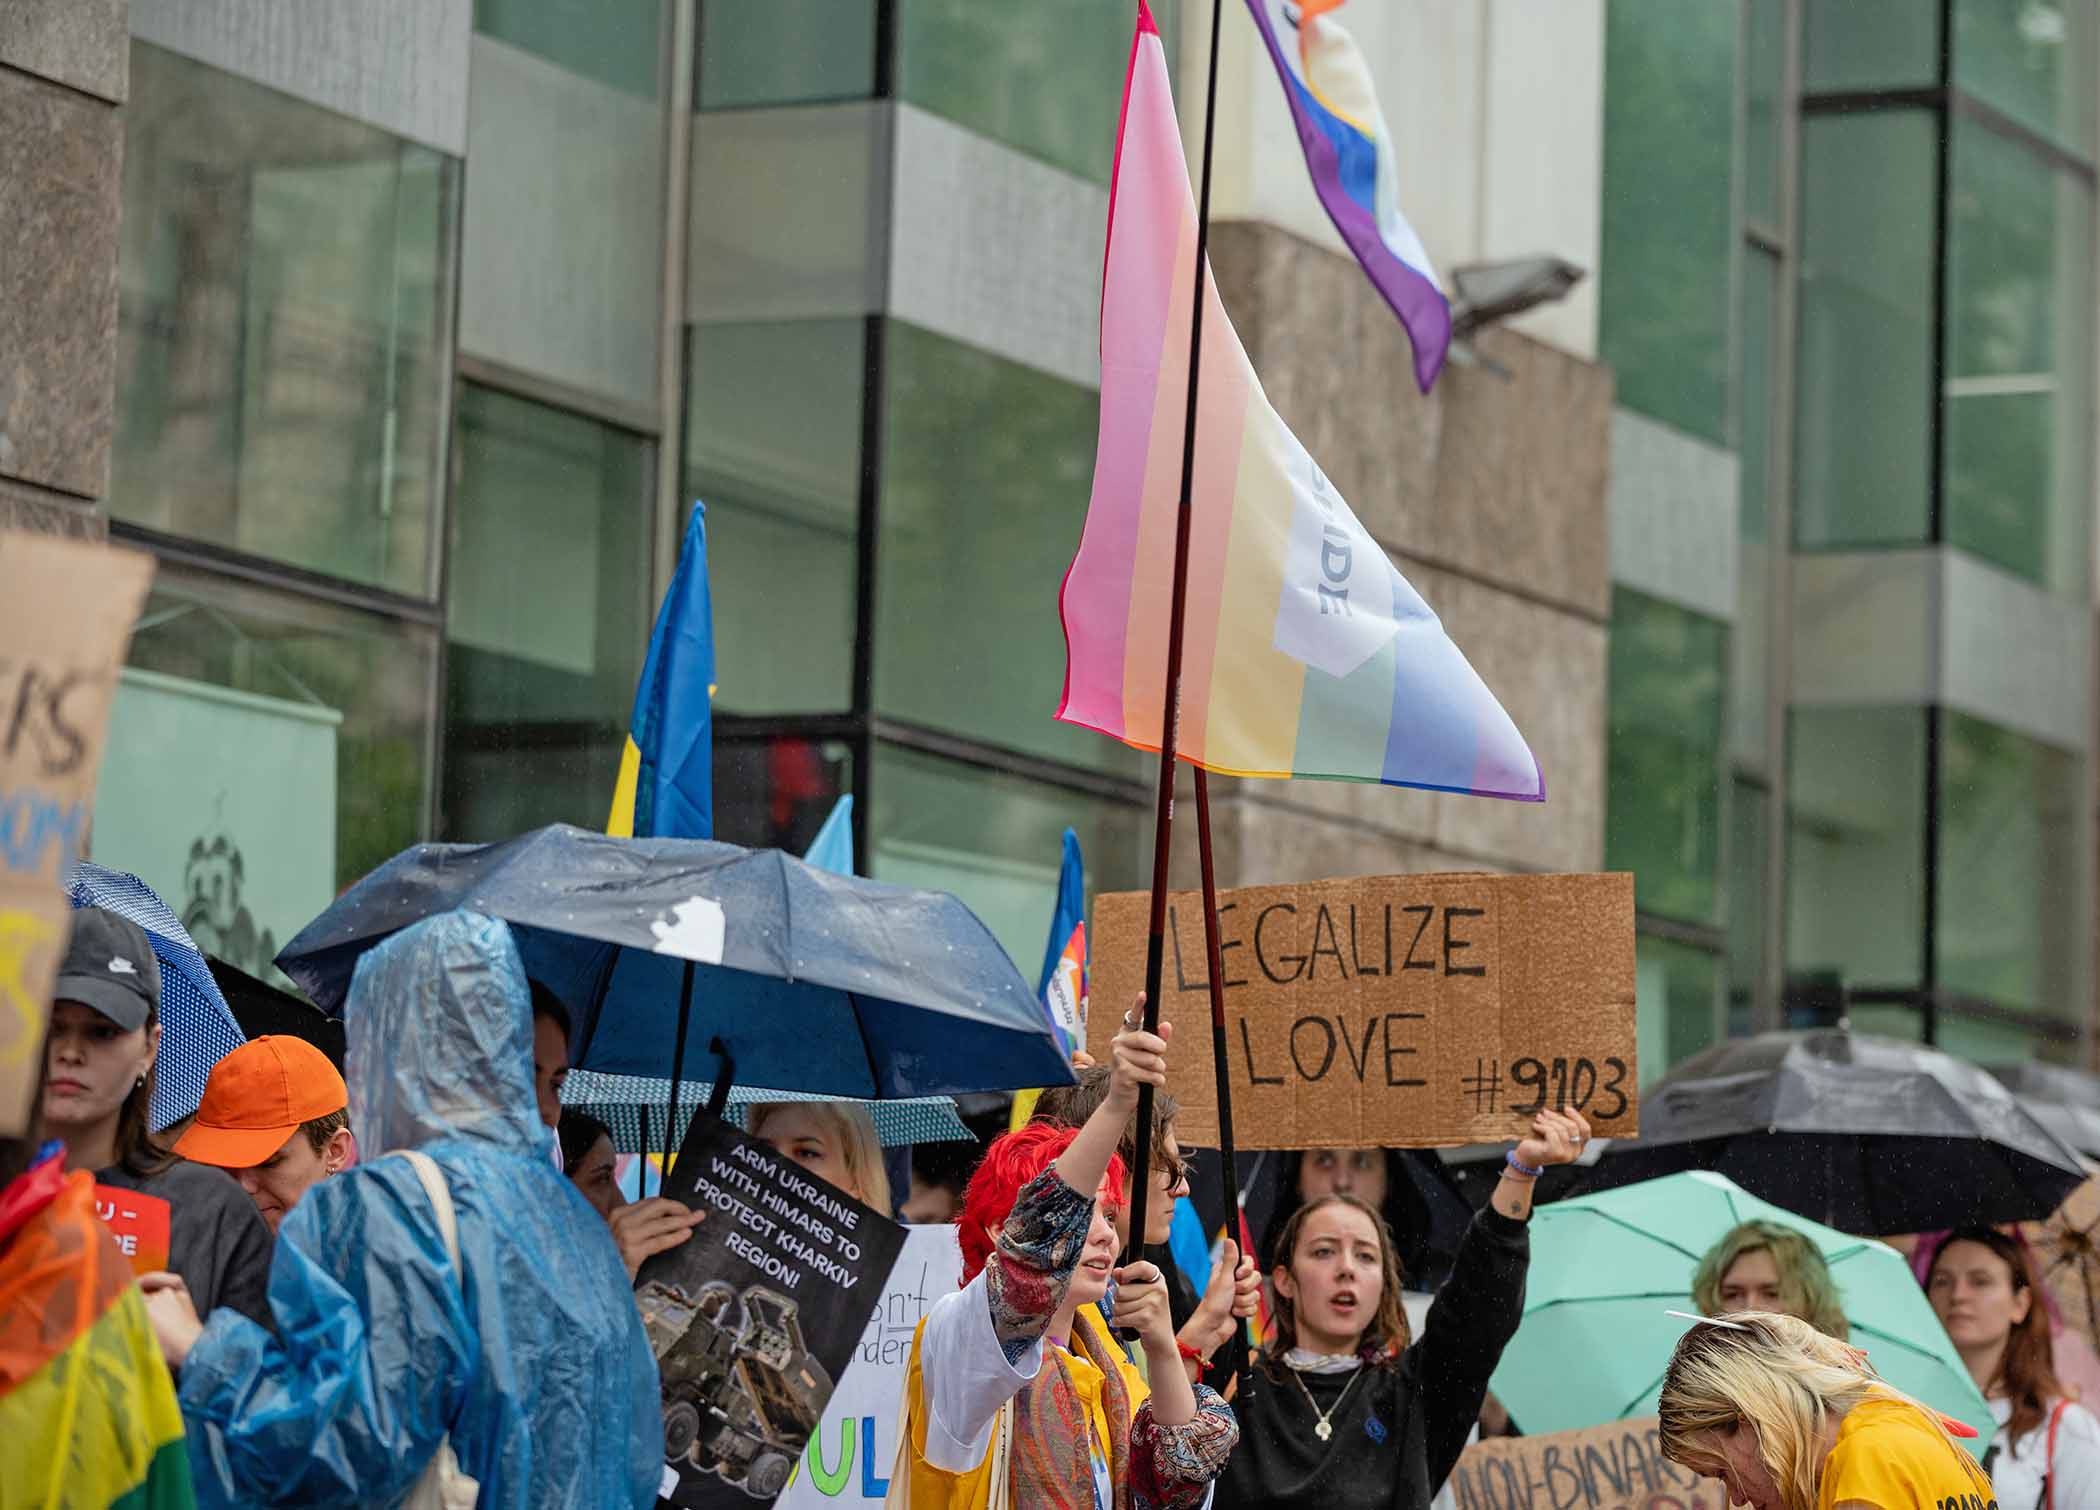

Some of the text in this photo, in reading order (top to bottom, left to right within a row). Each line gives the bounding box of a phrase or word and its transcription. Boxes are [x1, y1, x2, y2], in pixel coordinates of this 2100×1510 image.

[1169, 902, 1486, 993] LEGALIZE
[1239, 1013, 1427, 1087] LOVE
[711, 1157, 861, 1261] WITH HIMARS TO
[731, 1143, 860, 1231] ARM UKRAINE
[694, 1177, 858, 1289] PROTECT KHARKIV
[725, 1231, 800, 1289] REGION!
[788, 1415, 890, 1498] UL
[1456, 1429, 1703, 1510] NON-BINAR
